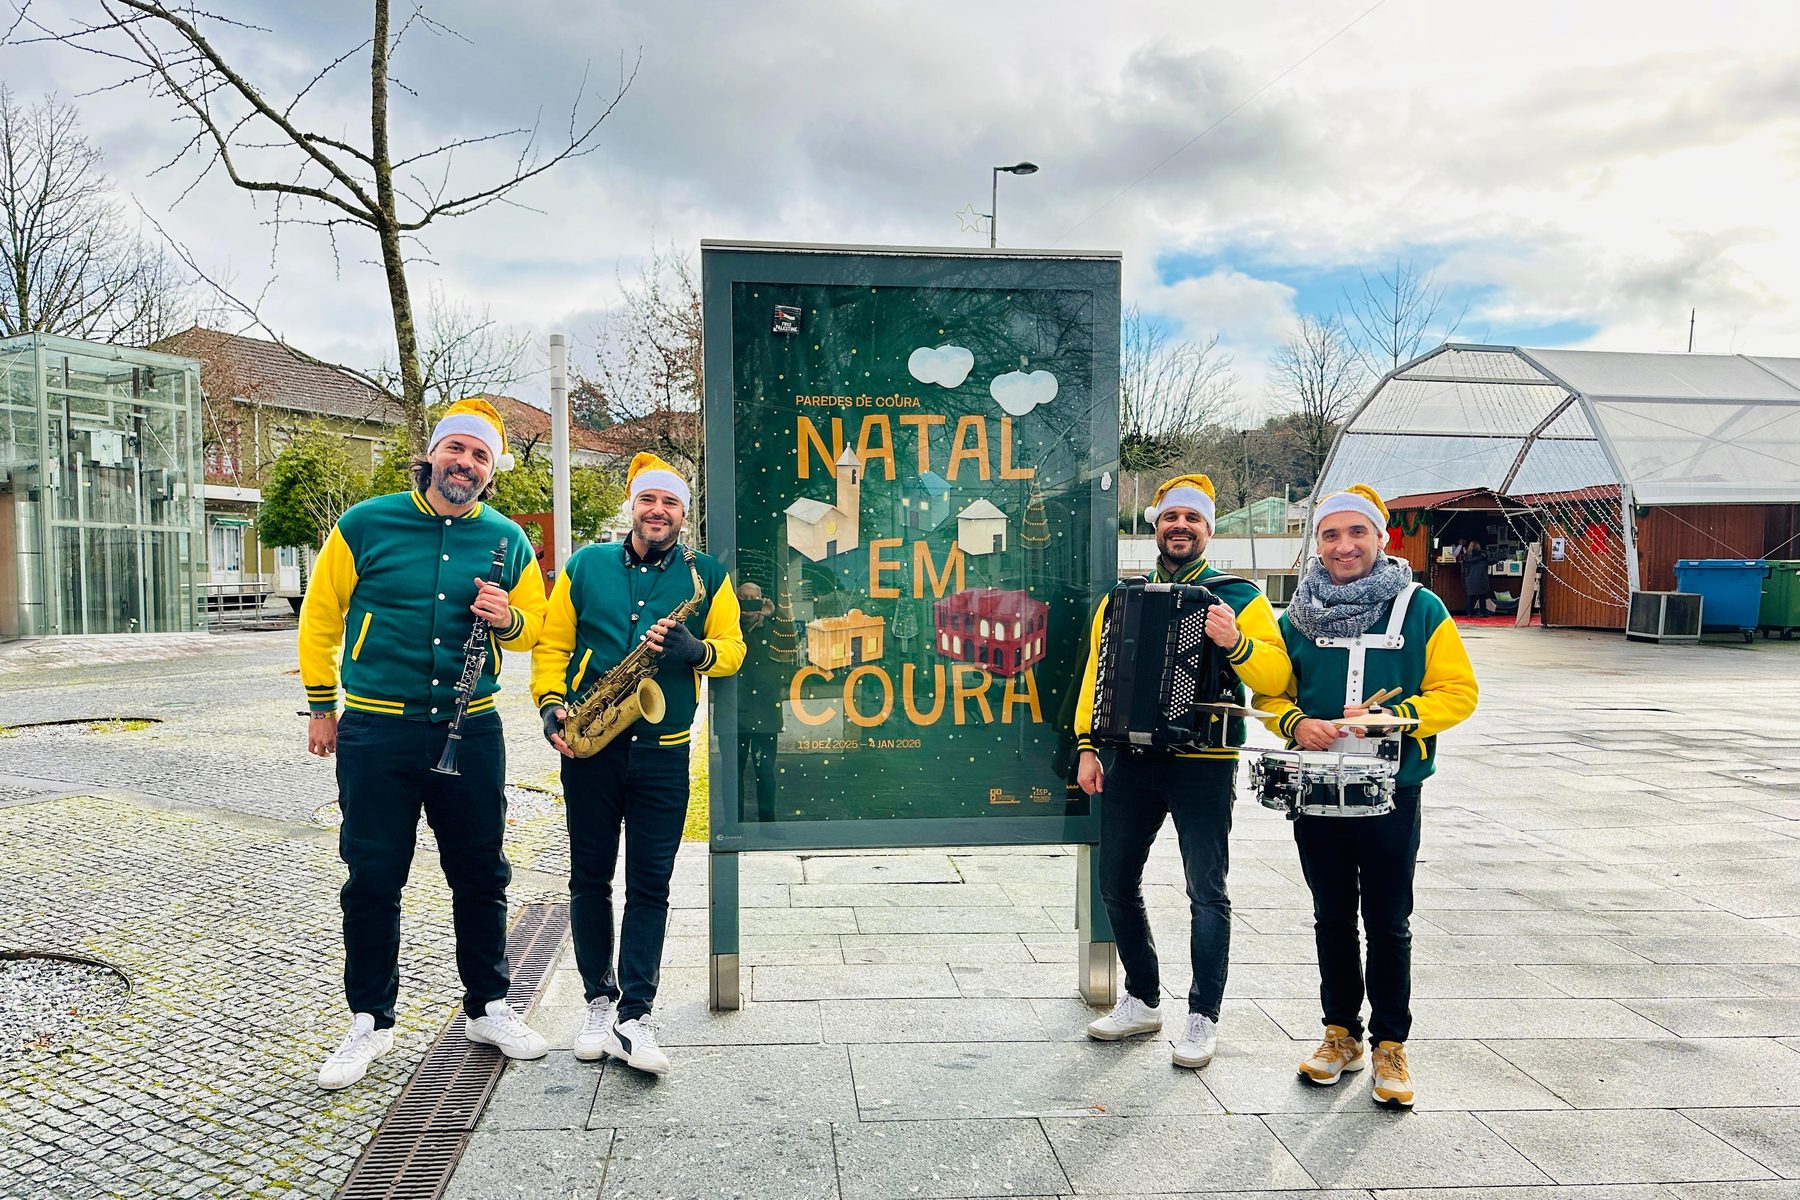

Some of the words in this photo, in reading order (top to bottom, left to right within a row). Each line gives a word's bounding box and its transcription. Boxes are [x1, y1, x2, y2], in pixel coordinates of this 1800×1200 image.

[795, 395, 853, 407] PAREDES
[856, 396, 873, 407] DE
[875, 396, 921, 408] COURA
[797, 414, 1036, 481] NATAL
[869, 538, 965, 599] EM
[789, 663, 1043, 728] COURA
[798, 740, 810, 749] 13
[812, 740, 831, 749] DEZ
[832, 740, 858, 749] 2025
[877, 739, 894, 749] JAN
[896, 739, 921, 748] 2026
